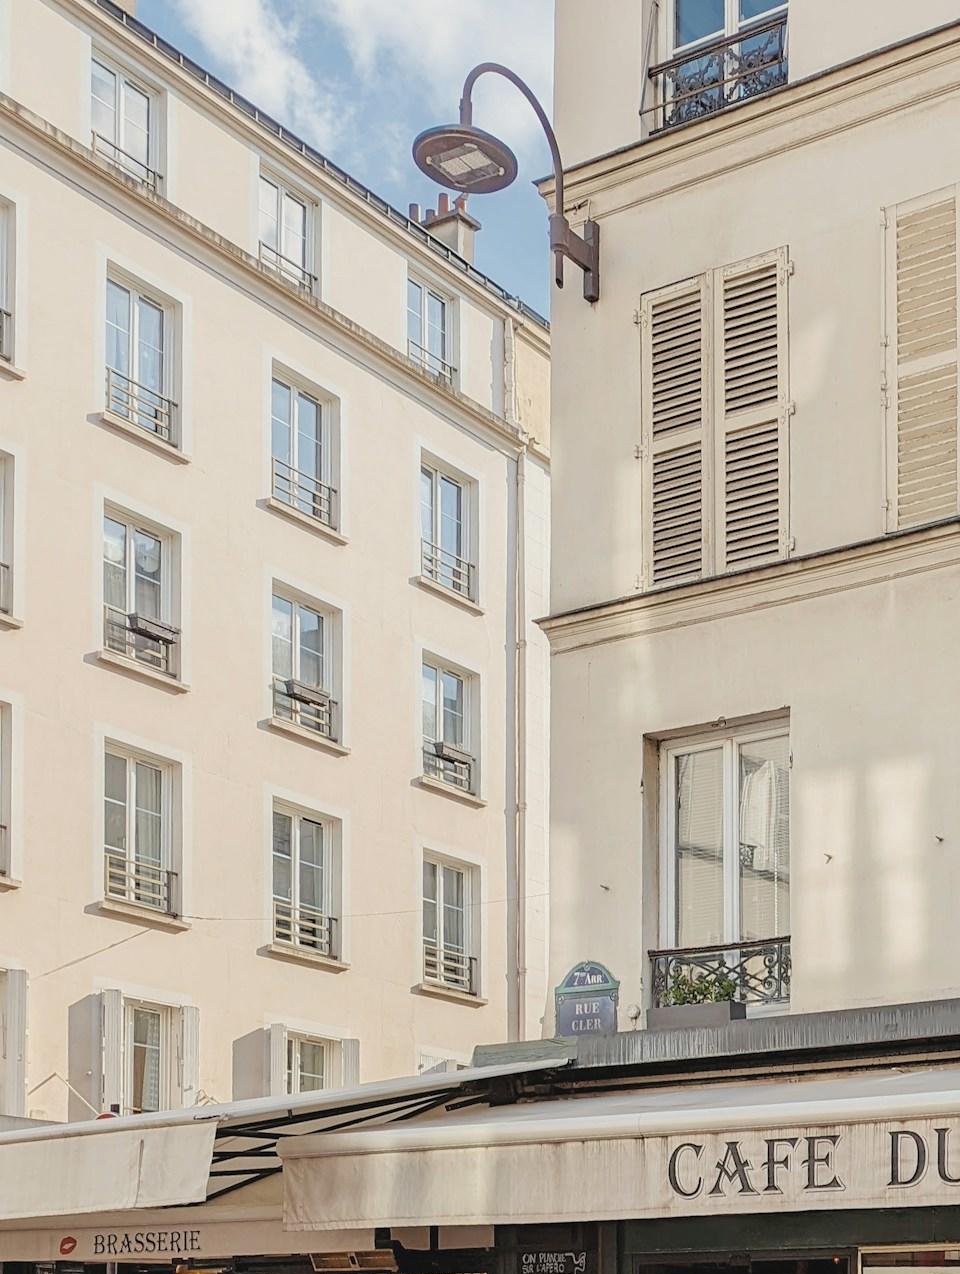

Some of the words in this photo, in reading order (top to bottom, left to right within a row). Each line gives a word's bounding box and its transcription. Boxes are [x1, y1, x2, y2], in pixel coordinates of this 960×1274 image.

[575, 1002, 600, 1015] RUE
[571, 1018, 601, 1031] CLER
[667, 1133, 845, 1199] CAFE
[94, 1231, 201, 1254] BRASSERIE
[522, 1253, 536, 1264] ON
[521, 1264, 534, 1274] SUR
